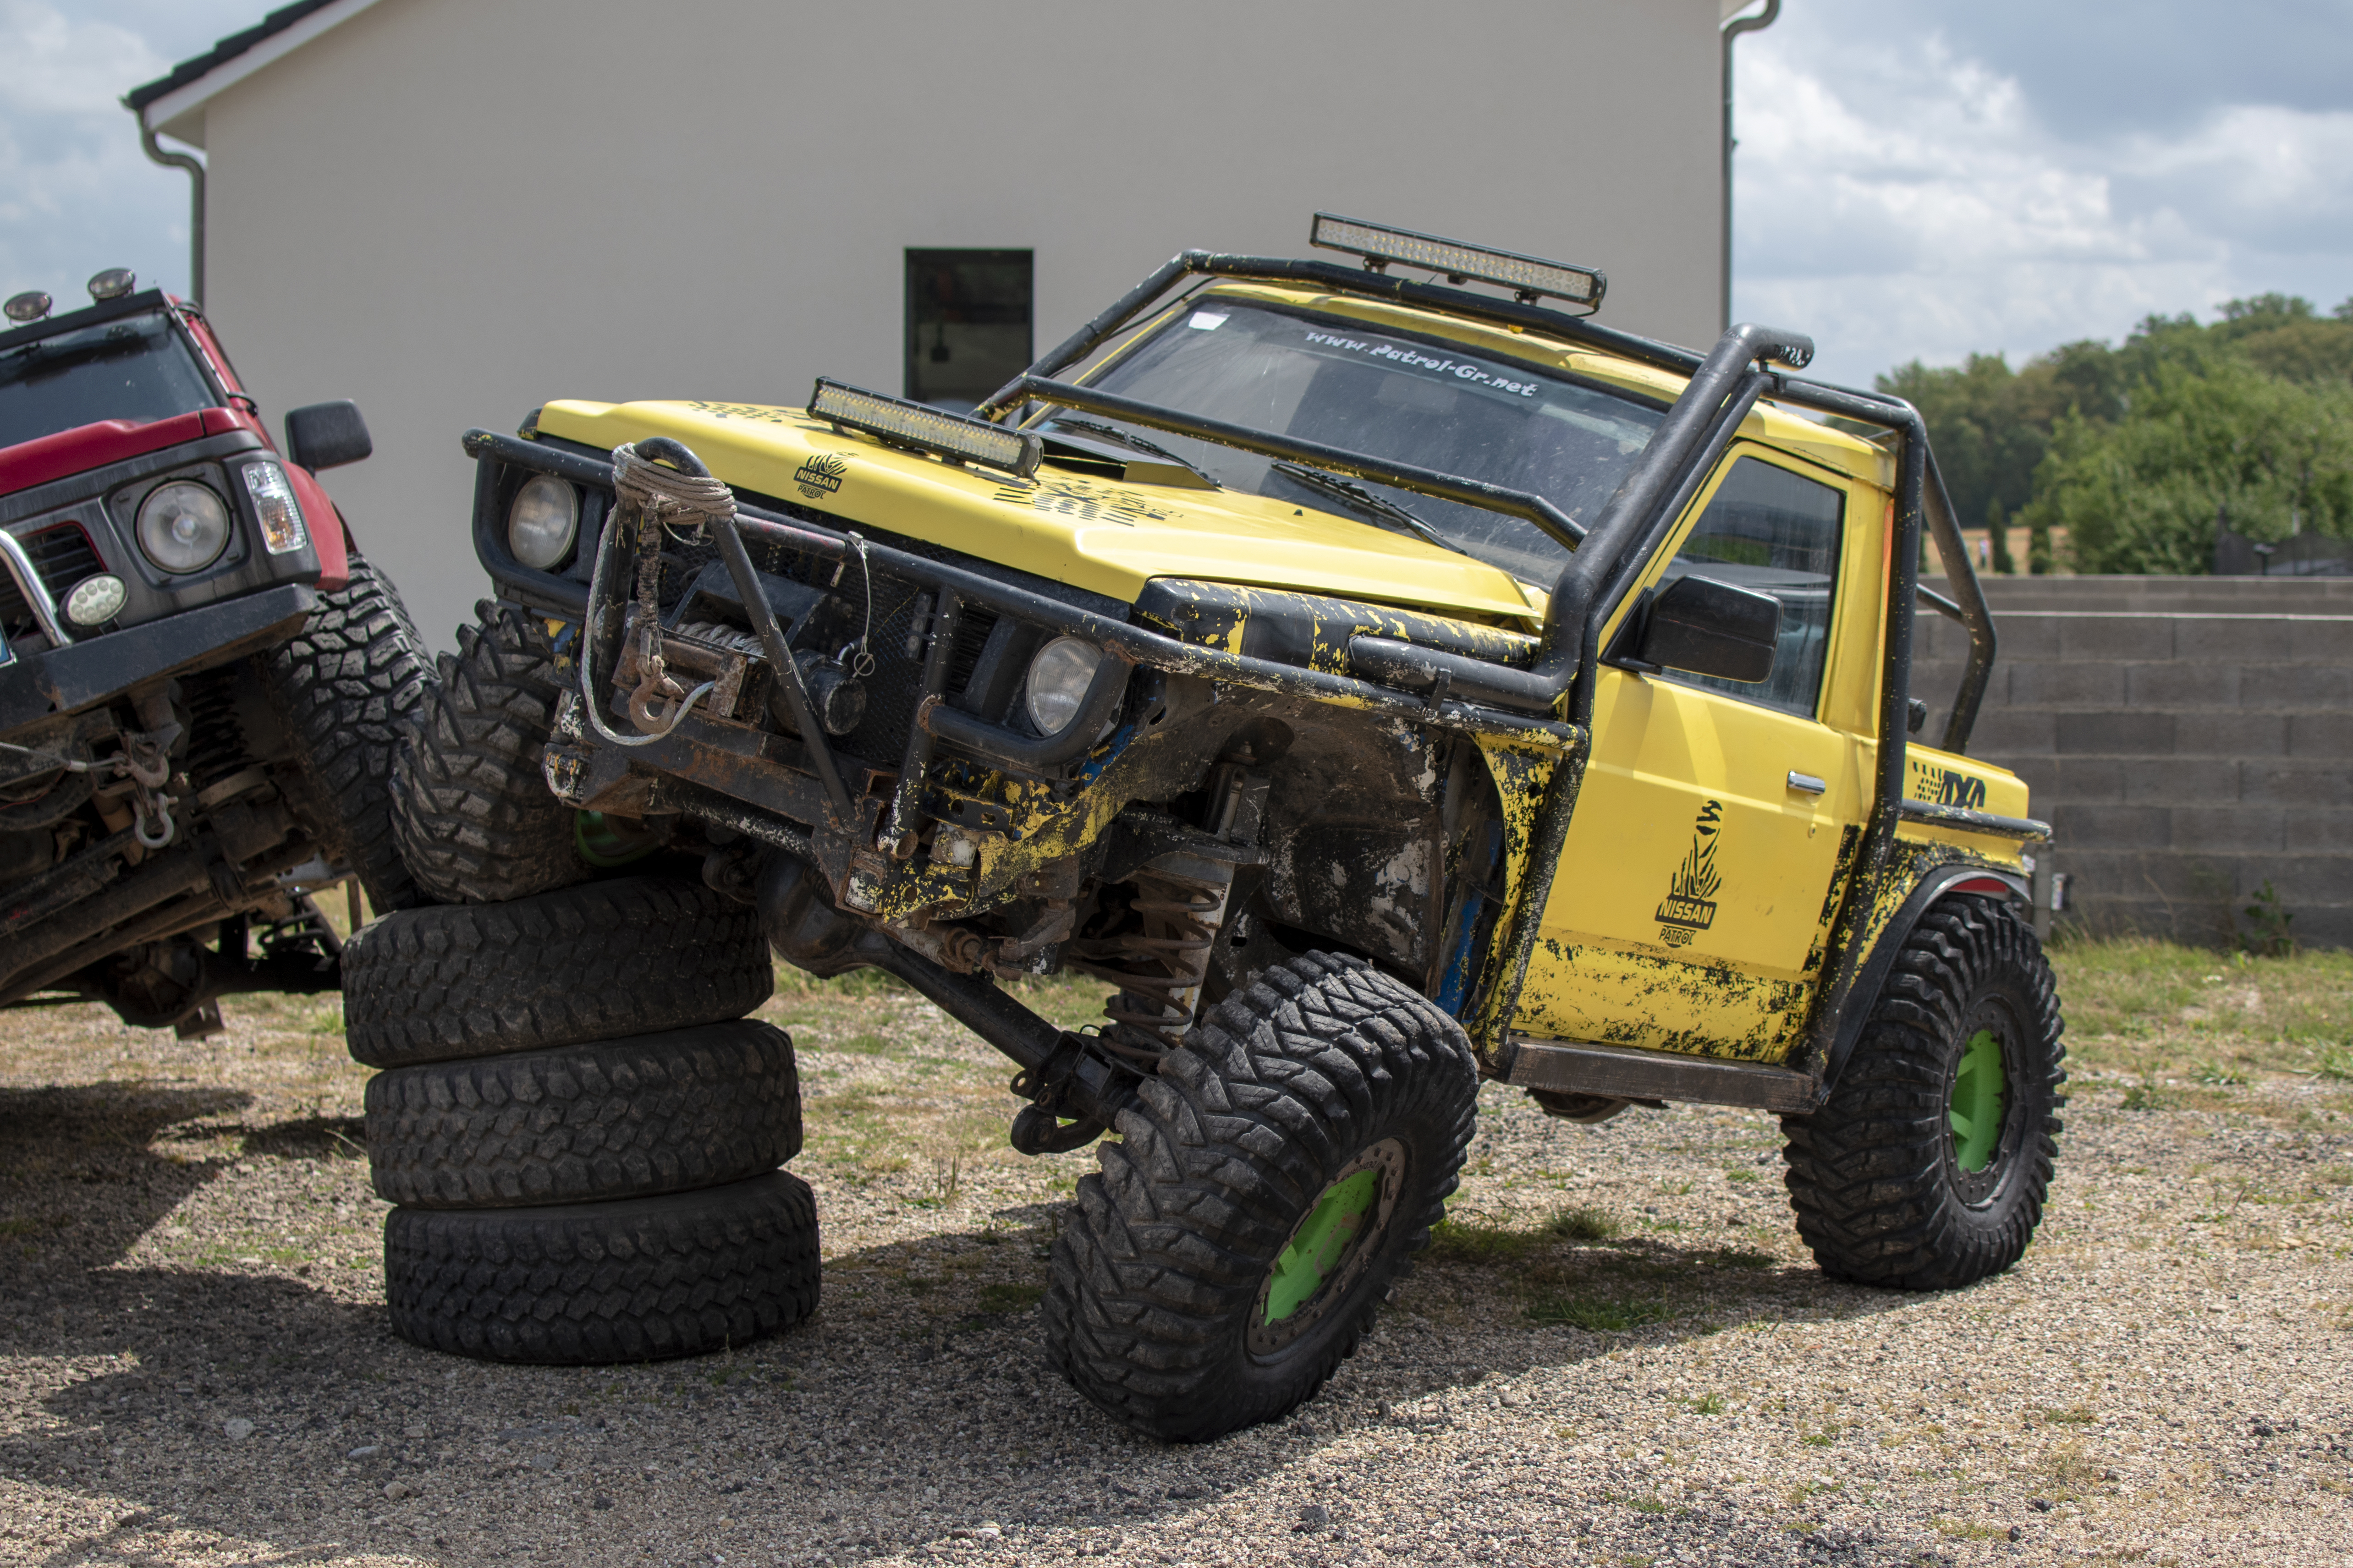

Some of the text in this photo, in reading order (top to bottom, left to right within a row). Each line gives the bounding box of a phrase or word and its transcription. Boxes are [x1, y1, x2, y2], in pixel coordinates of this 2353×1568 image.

[797, 469, 839, 490] NISSAN
[797, 485, 826, 499] PATROL
[1658, 899, 1713, 924] NISSAN
[1658, 928, 1697, 945] PATROL
